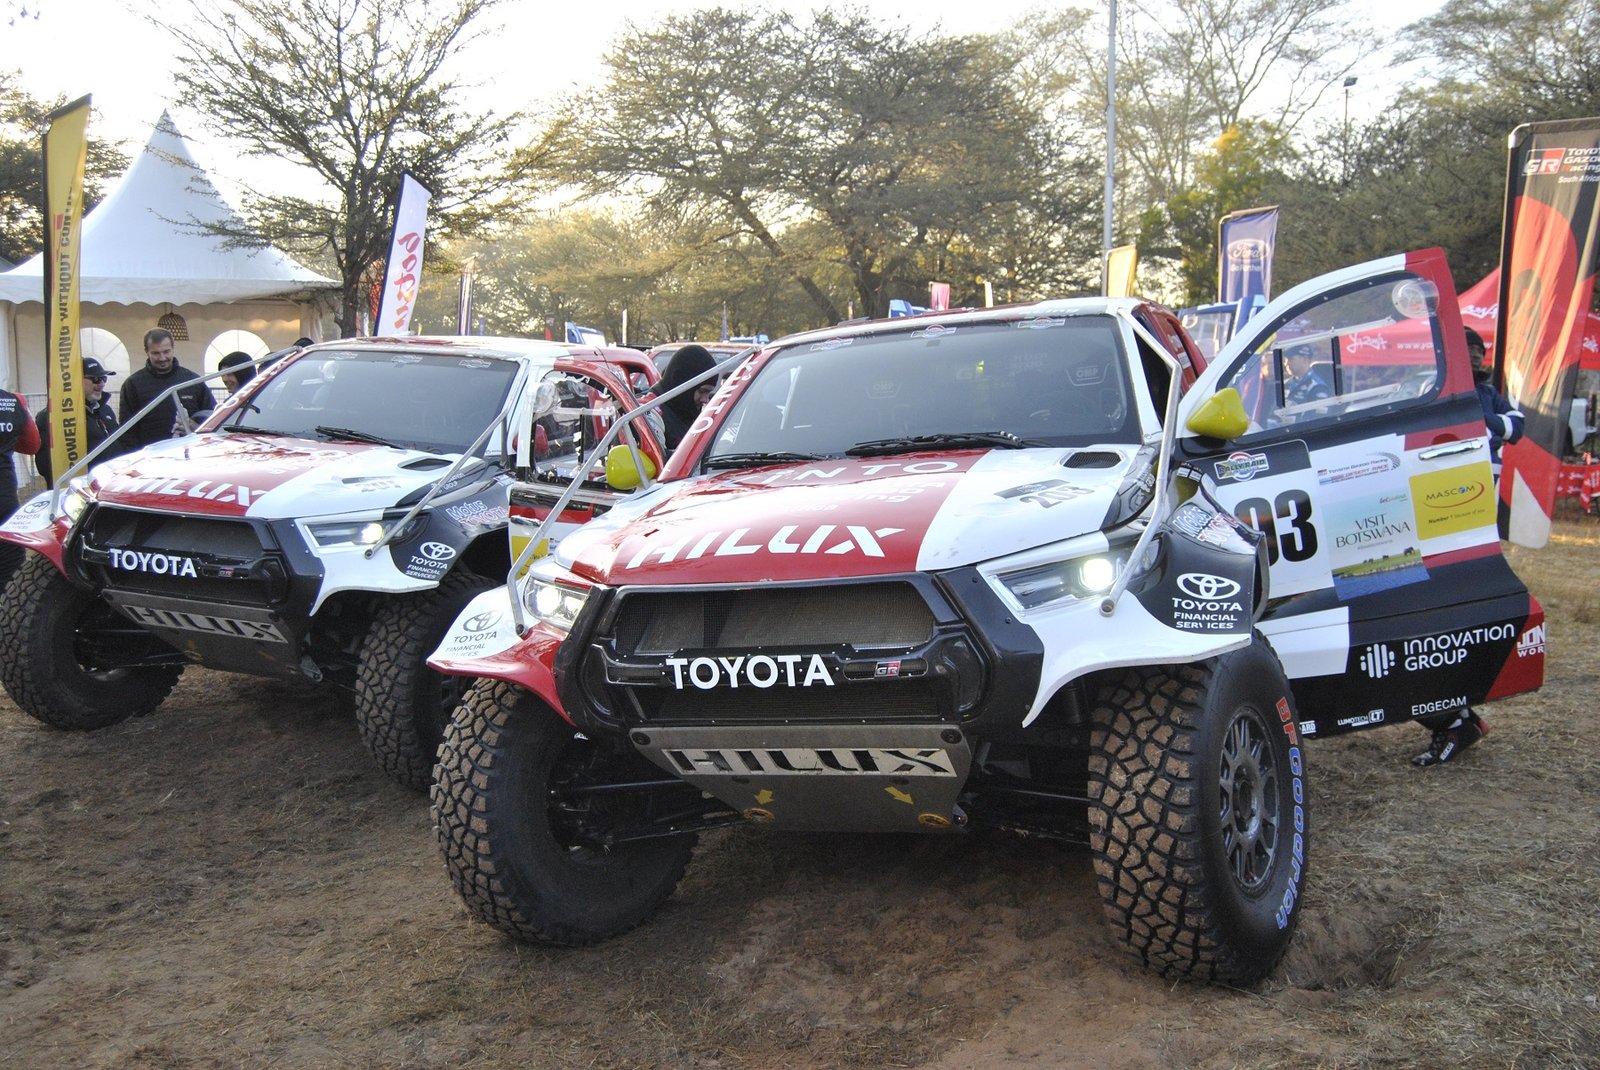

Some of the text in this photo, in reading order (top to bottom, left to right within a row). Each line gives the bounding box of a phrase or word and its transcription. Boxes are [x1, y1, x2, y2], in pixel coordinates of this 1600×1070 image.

[1523, 158, 1560, 174] GR
[59, 252, 71, 321] WITHOUT
[59, 326, 72, 392] NOTHING
[62, 397, 75, 413] IS
[112, 478, 268, 508] HILUX
[1425, 485, 1476, 501] MASCOM
[445, 500, 489, 520] Motus
[1355, 513, 1387, 530] VISIT
[1428, 516, 1449, 524] Number
[1336, 521, 1411, 548] BOTSWANA
[625, 523, 906, 569] HILUX
[110, 548, 198, 578] TOYOTA
[407, 564, 441, 575] FINANCIAL
[410, 555, 449, 570] TOYOTA
[405, 569, 437, 580] SERVICES
[1172, 597, 1243, 612] TOYOTA
[126, 605, 284, 641] HILUX
[1174, 611, 1238, 621] FINANCIAL
[454, 631, 498, 643] TOYOTA
[1404, 623, 1515, 655] INNOVATION
[1405, 648, 1468, 671] GROUP
[665, 654, 835, 690] TOYOTA
[876, 667, 899, 676] GR
[1371, 710, 1382, 721] LT
[1411, 697, 1468, 716] EDGECAM
[667, 749, 950, 773] HILUX
